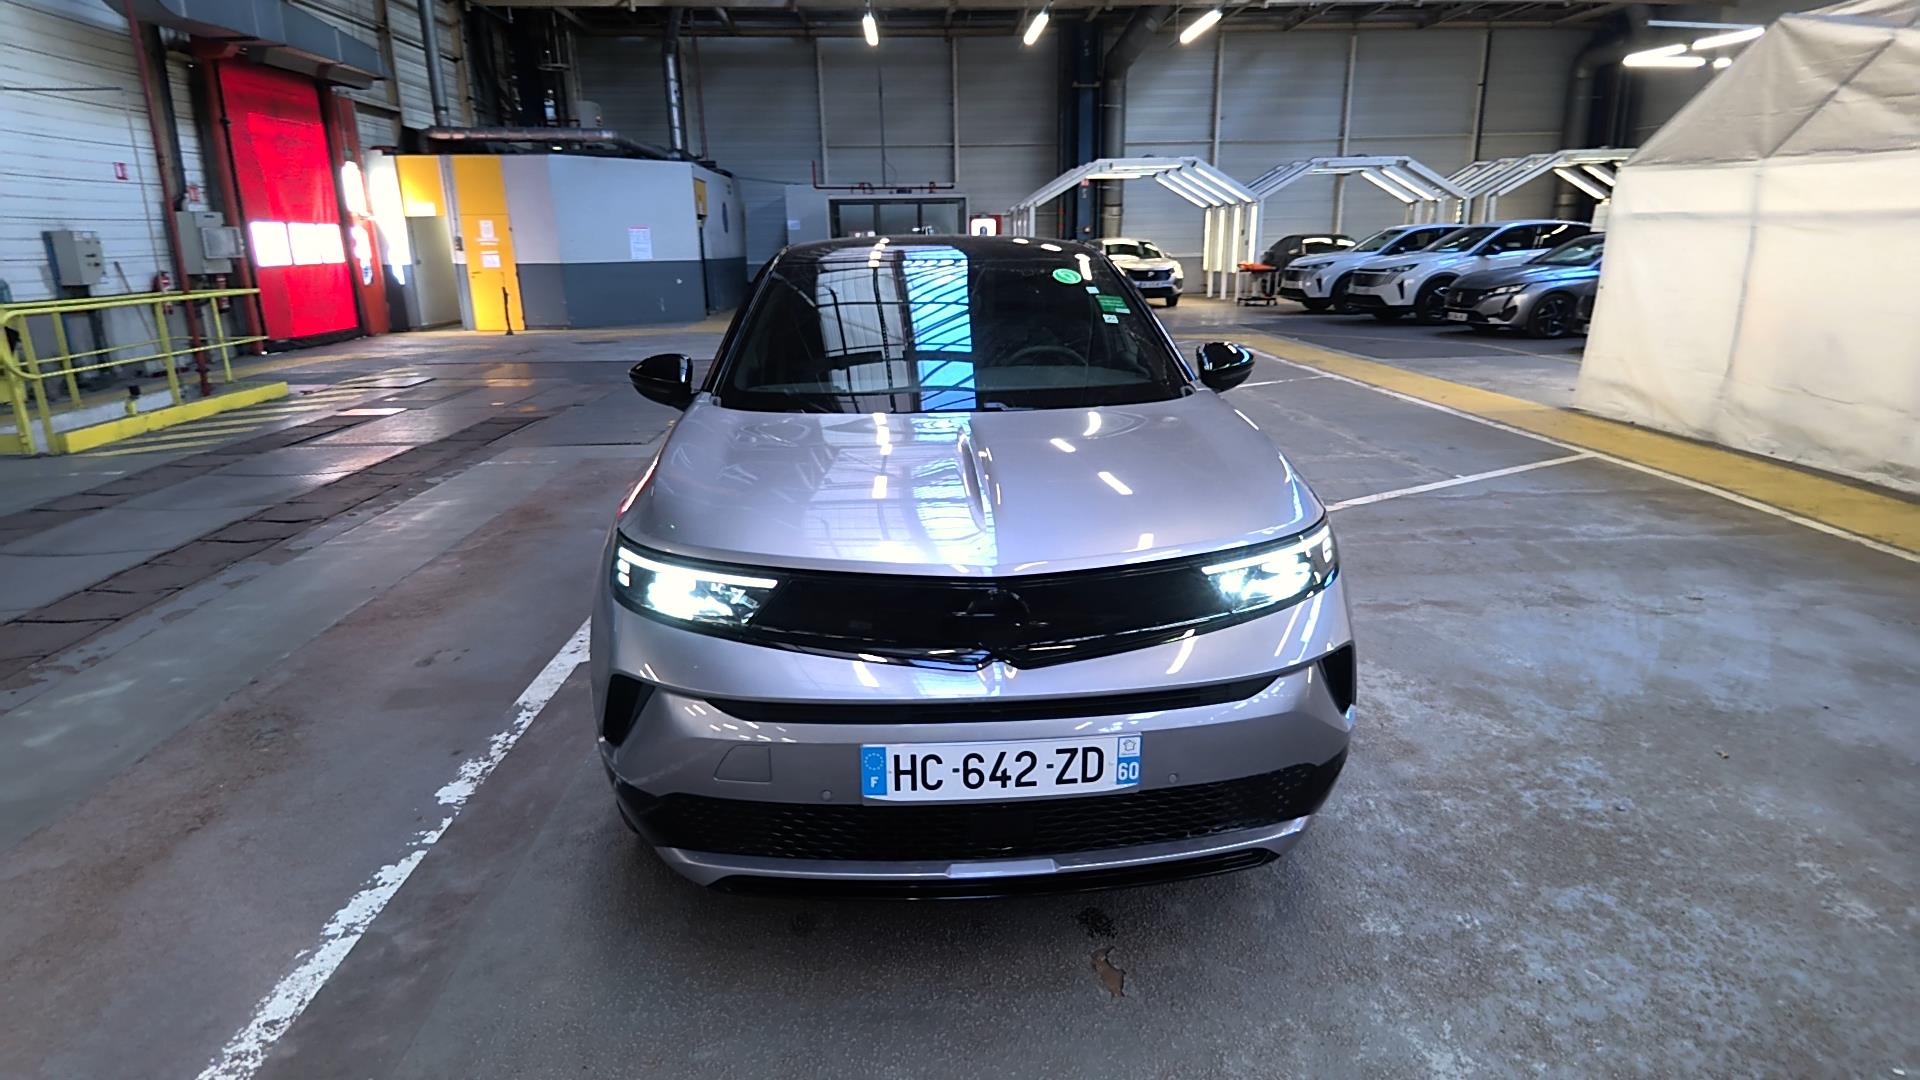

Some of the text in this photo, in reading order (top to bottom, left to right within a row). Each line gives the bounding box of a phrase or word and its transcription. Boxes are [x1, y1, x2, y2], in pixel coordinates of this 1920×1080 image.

[870, 746, 1139, 791] F HC-642-ZD 60
